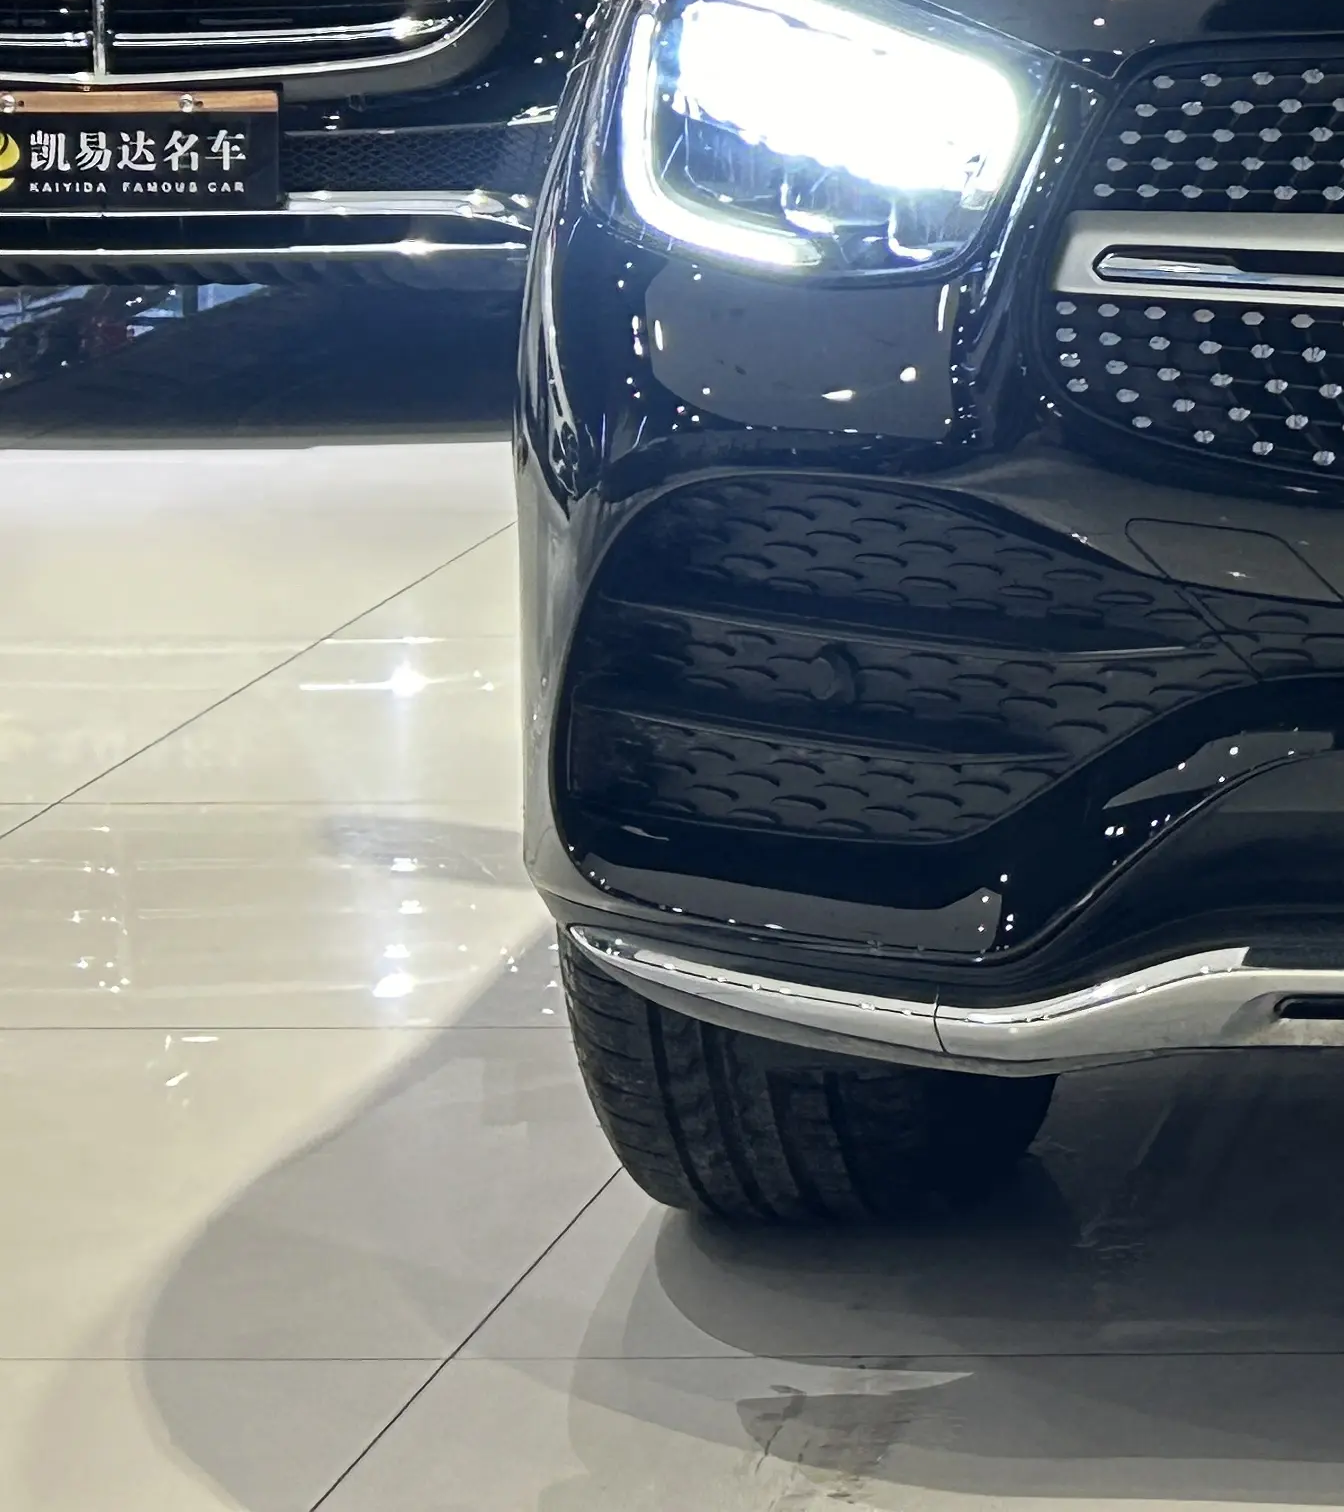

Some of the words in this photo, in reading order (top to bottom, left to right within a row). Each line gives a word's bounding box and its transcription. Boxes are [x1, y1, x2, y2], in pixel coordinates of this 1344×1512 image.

[29, 129, 247, 172] 凯易达名车
[29, 181, 107, 193] KAIYIDA
[122, 181, 198, 193] FAMOUS
[207, 181, 245, 193] CAR
